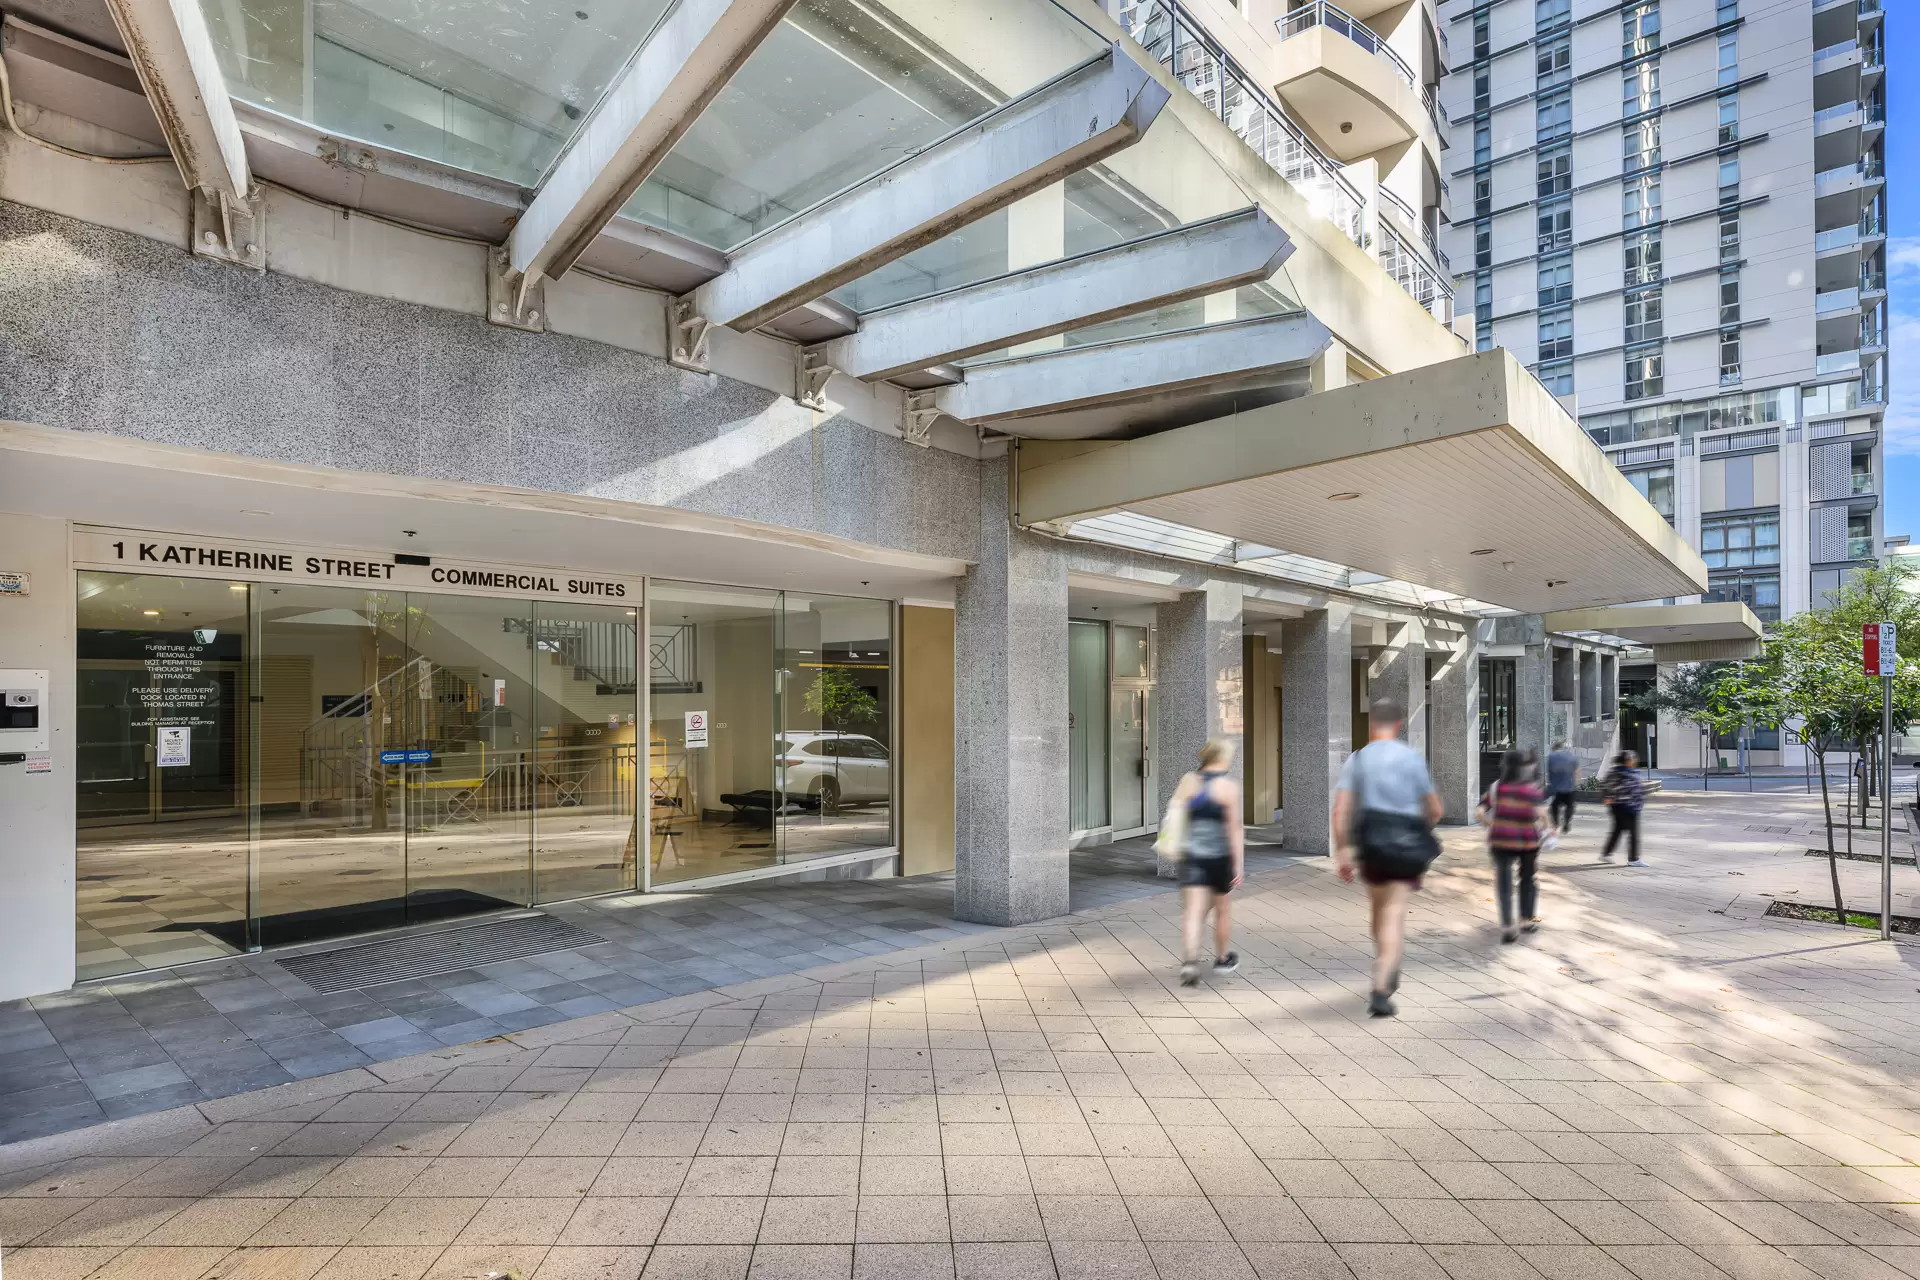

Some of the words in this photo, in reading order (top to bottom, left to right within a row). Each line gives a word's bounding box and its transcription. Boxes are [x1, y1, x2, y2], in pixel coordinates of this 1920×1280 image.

[113, 541, 124, 559] 1
[139, 543, 293, 572] KATHERINE
[305, 557, 395, 580] STREET
[431, 568, 559, 592] COMMERCIAL
[568, 579, 626, 597] SUITES
[145, 644, 185, 652] FURNITURE
